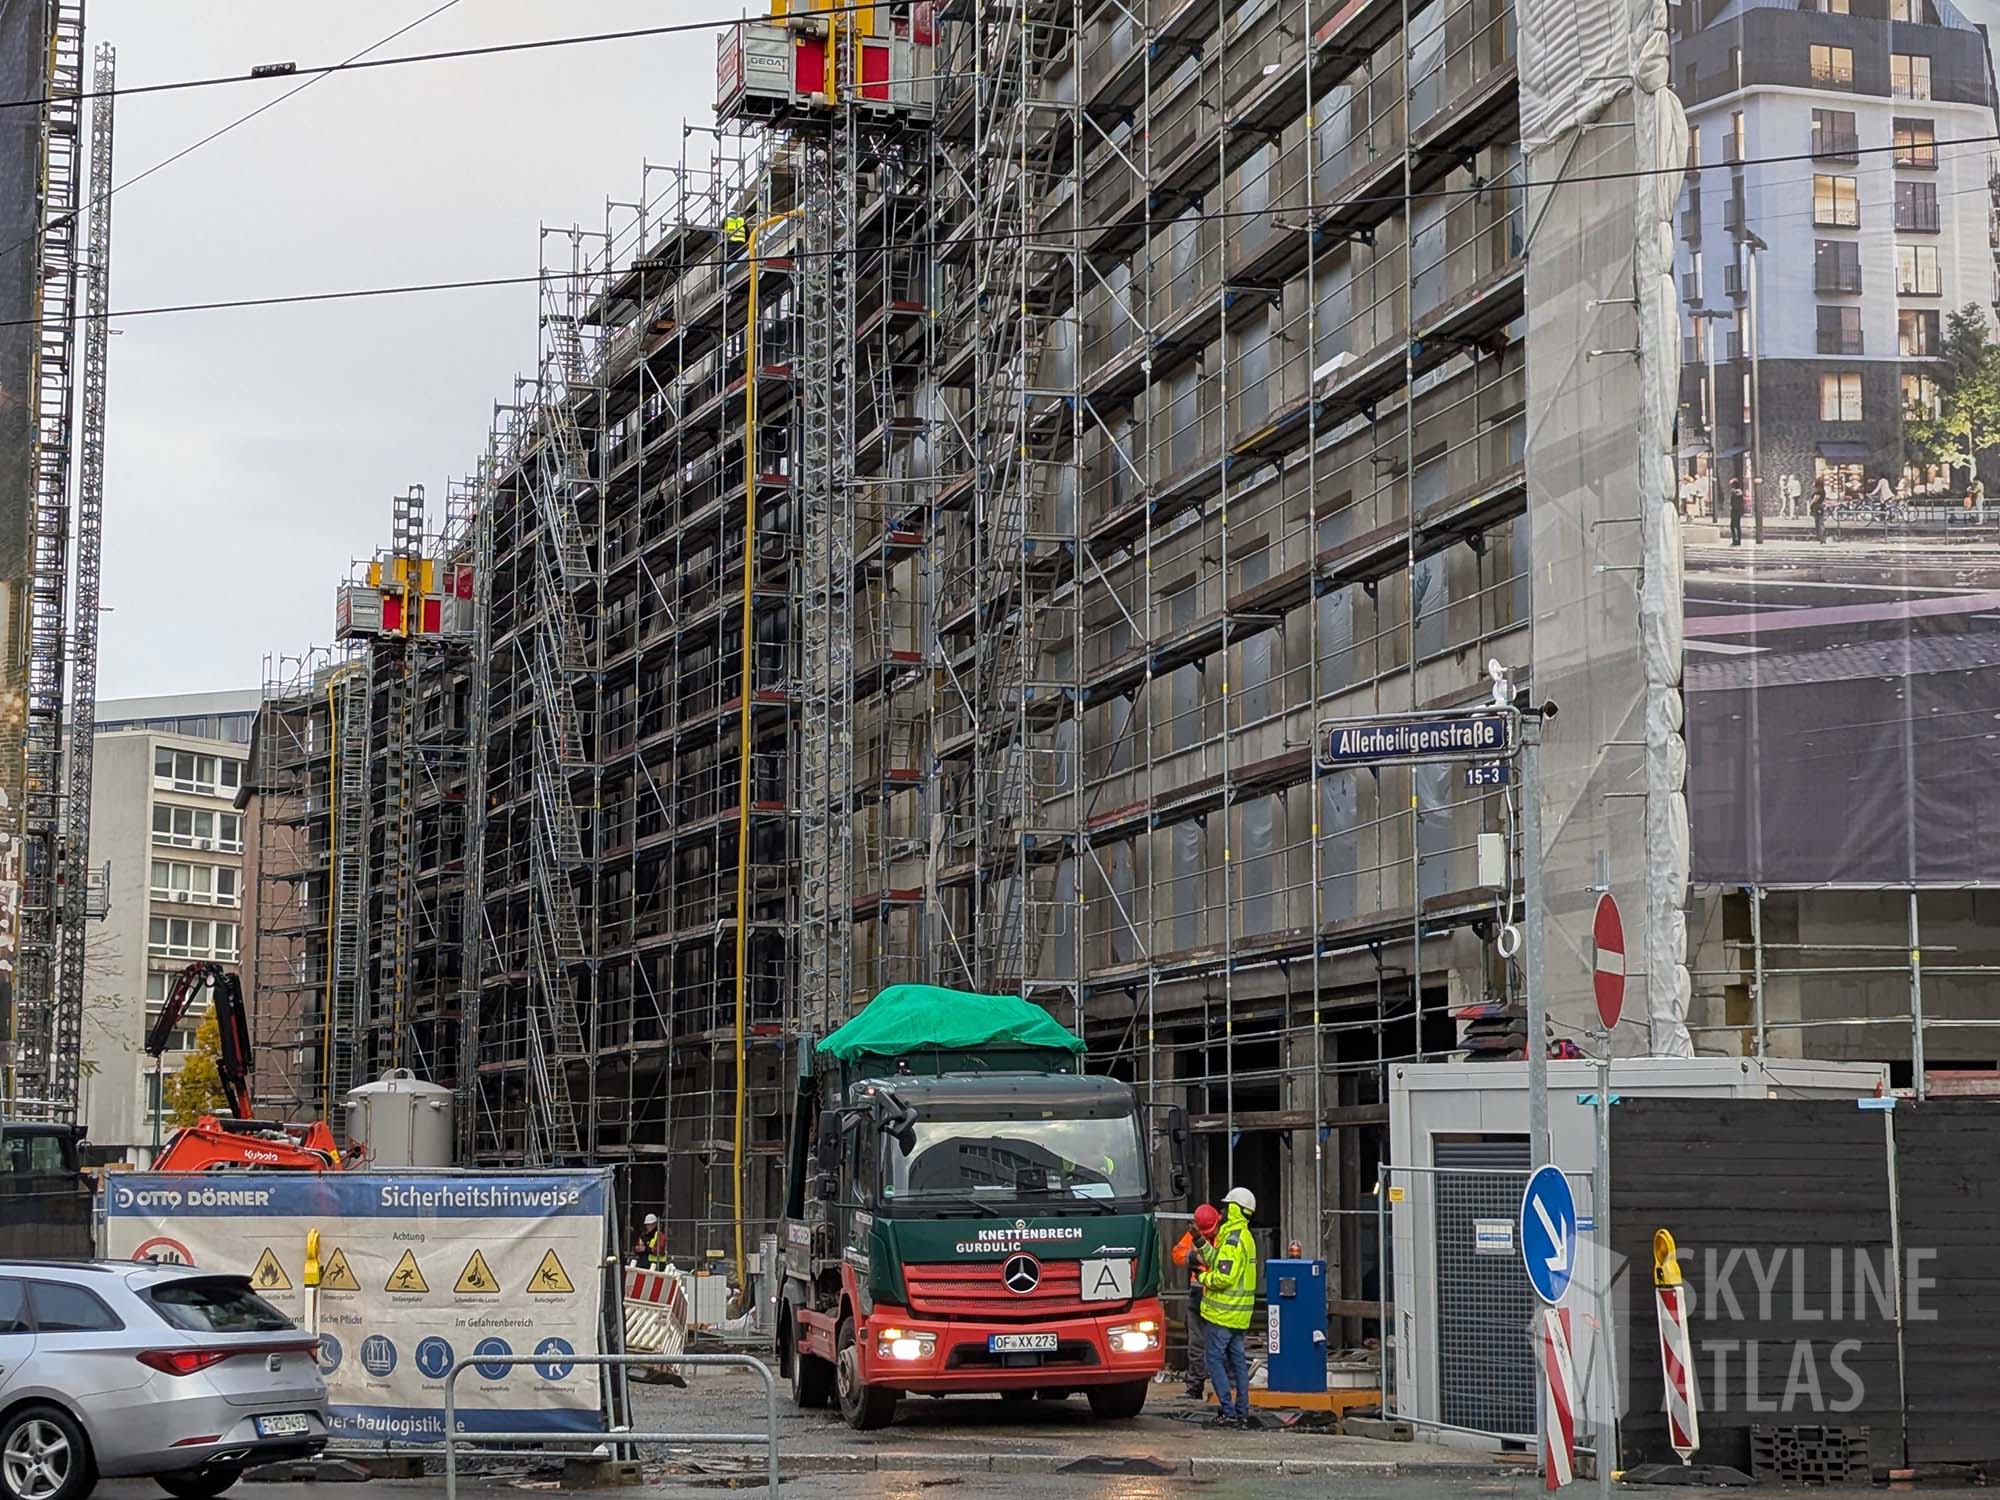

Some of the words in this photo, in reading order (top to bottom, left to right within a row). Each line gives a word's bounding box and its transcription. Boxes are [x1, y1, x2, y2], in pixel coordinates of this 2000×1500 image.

[1339, 720, 1495, 754] Allerheiligenstraße
[1467, 767, 1500, 785] 15-3
[244, 1150, 278, 1161] Kubota
[136, 1190, 182, 1208] OTTO
[187, 1188, 270, 1206] DÖRNER
[381, 1186, 580, 1207] Sicherheitshinweise
[392, 1232, 426, 1243] Achtung
[978, 1228, 1083, 1241] KNETTENBRECH
[956, 1241, 1022, 1254] GURDULIC
[1093, 1264, 1120, 1295] A
[455, 1317, 466, 1328] Im
[468, 1317, 534, 1328] Gefahrenbereich
[996, 1335, 1010, 1349] OF
[1018, 1335, 1034, 1348] XX
[1035, 1335, 1056, 1347] 273
